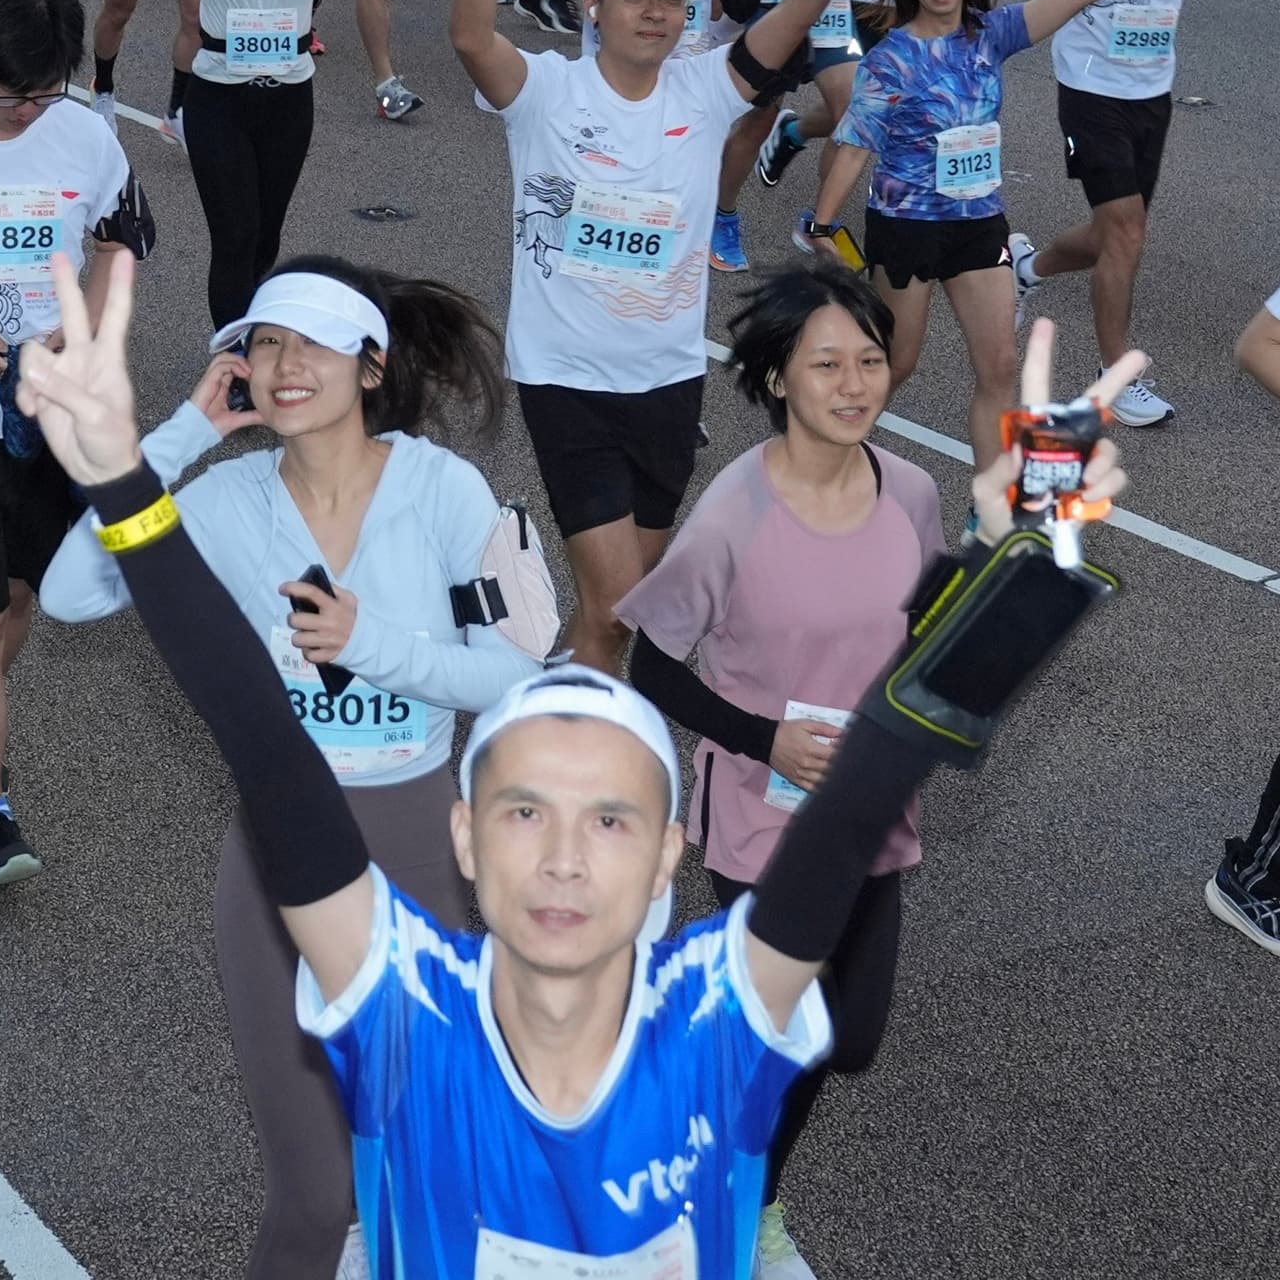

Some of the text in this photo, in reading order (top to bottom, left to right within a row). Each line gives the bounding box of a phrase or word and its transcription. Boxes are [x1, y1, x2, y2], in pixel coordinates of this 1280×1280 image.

[812, 14, 847, 28] 415
[234, 36, 291, 53] 38014
[1114, 30, 1171, 47] 32989
[946, 152, 992, 176] 31123
[577, 222, 662, 257] 34186
[287, 688, 411, 726] 38015
[384, 729, 413, 743] 06:45
